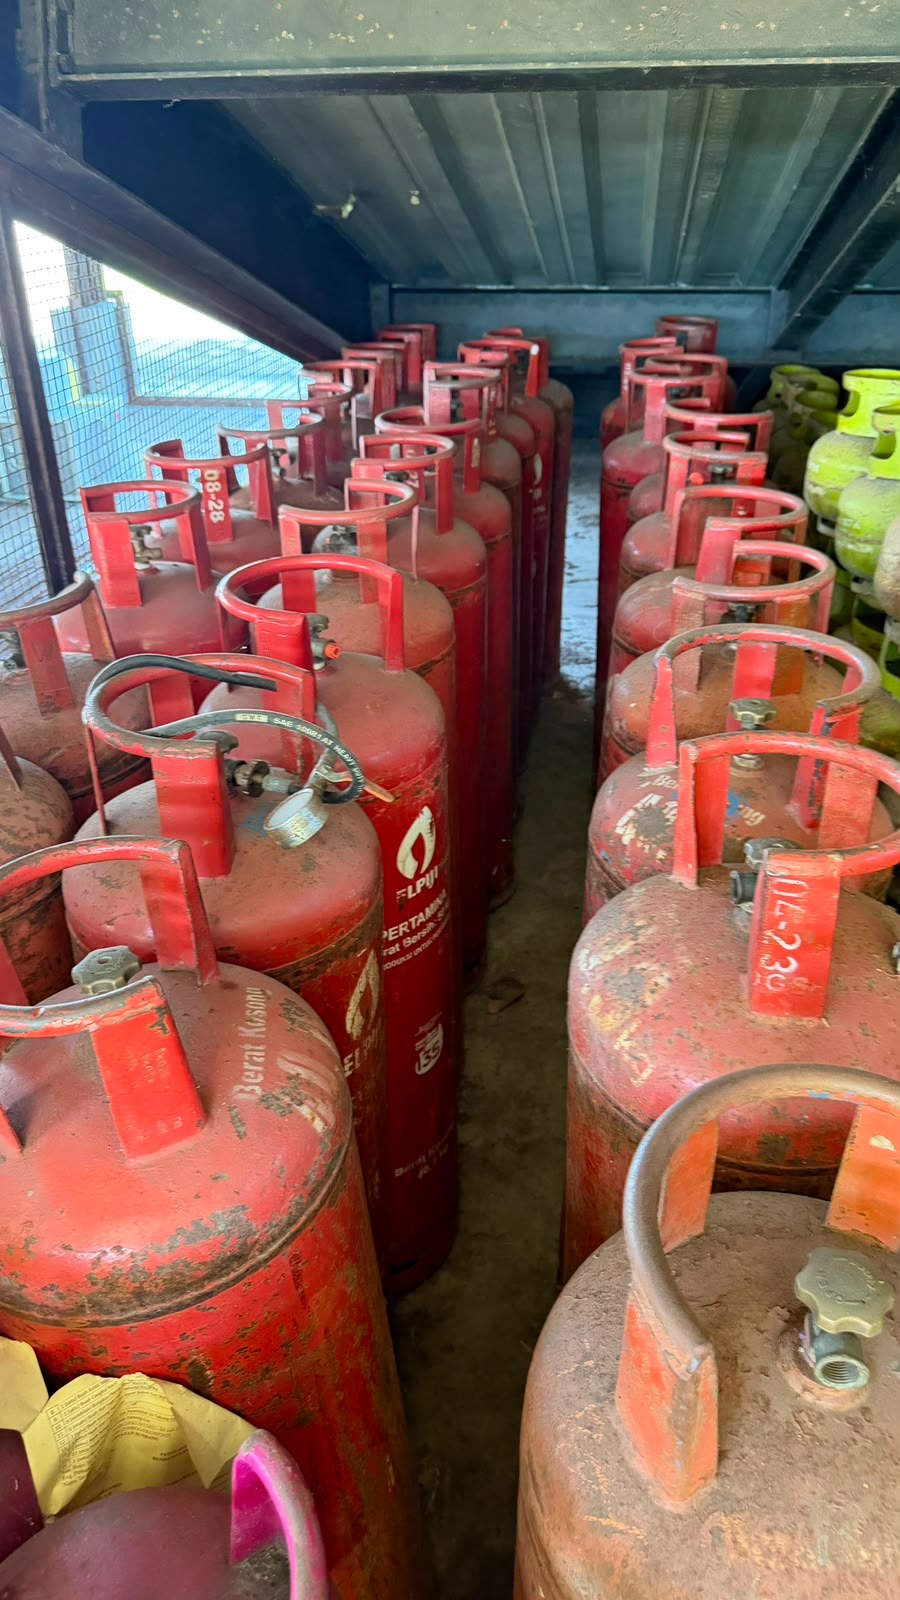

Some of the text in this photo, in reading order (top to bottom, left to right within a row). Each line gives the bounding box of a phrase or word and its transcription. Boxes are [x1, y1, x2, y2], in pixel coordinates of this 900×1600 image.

[203, 469, 225, 524] 08-28
[273, 717, 293, 728] SAE
[322, 737, 335, 746] AT
[333, 745, 356, 766] HEAVY
[232, 1044, 265, 1101] Berat
